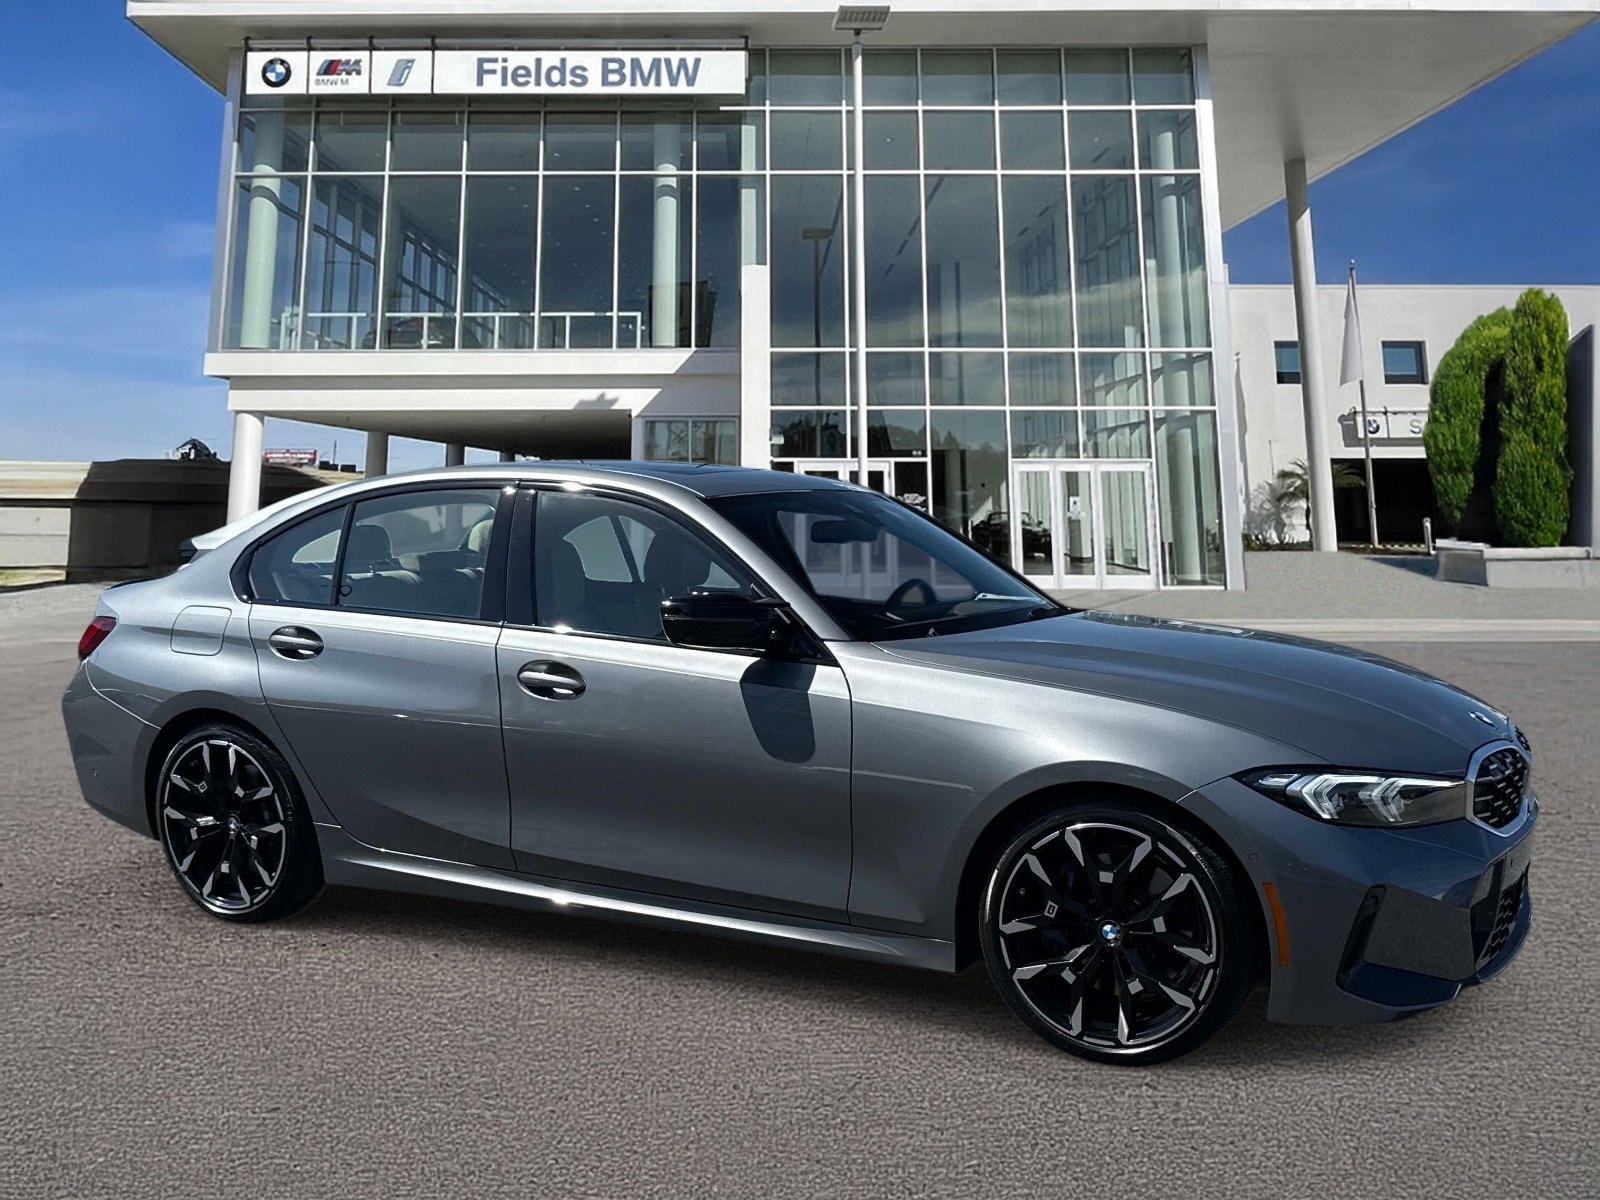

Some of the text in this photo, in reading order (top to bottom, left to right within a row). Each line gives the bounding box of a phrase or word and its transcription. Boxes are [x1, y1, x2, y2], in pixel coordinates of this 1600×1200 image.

[476, 57, 702, 87] Fields BMW
[314, 78, 339, 86] BMW
